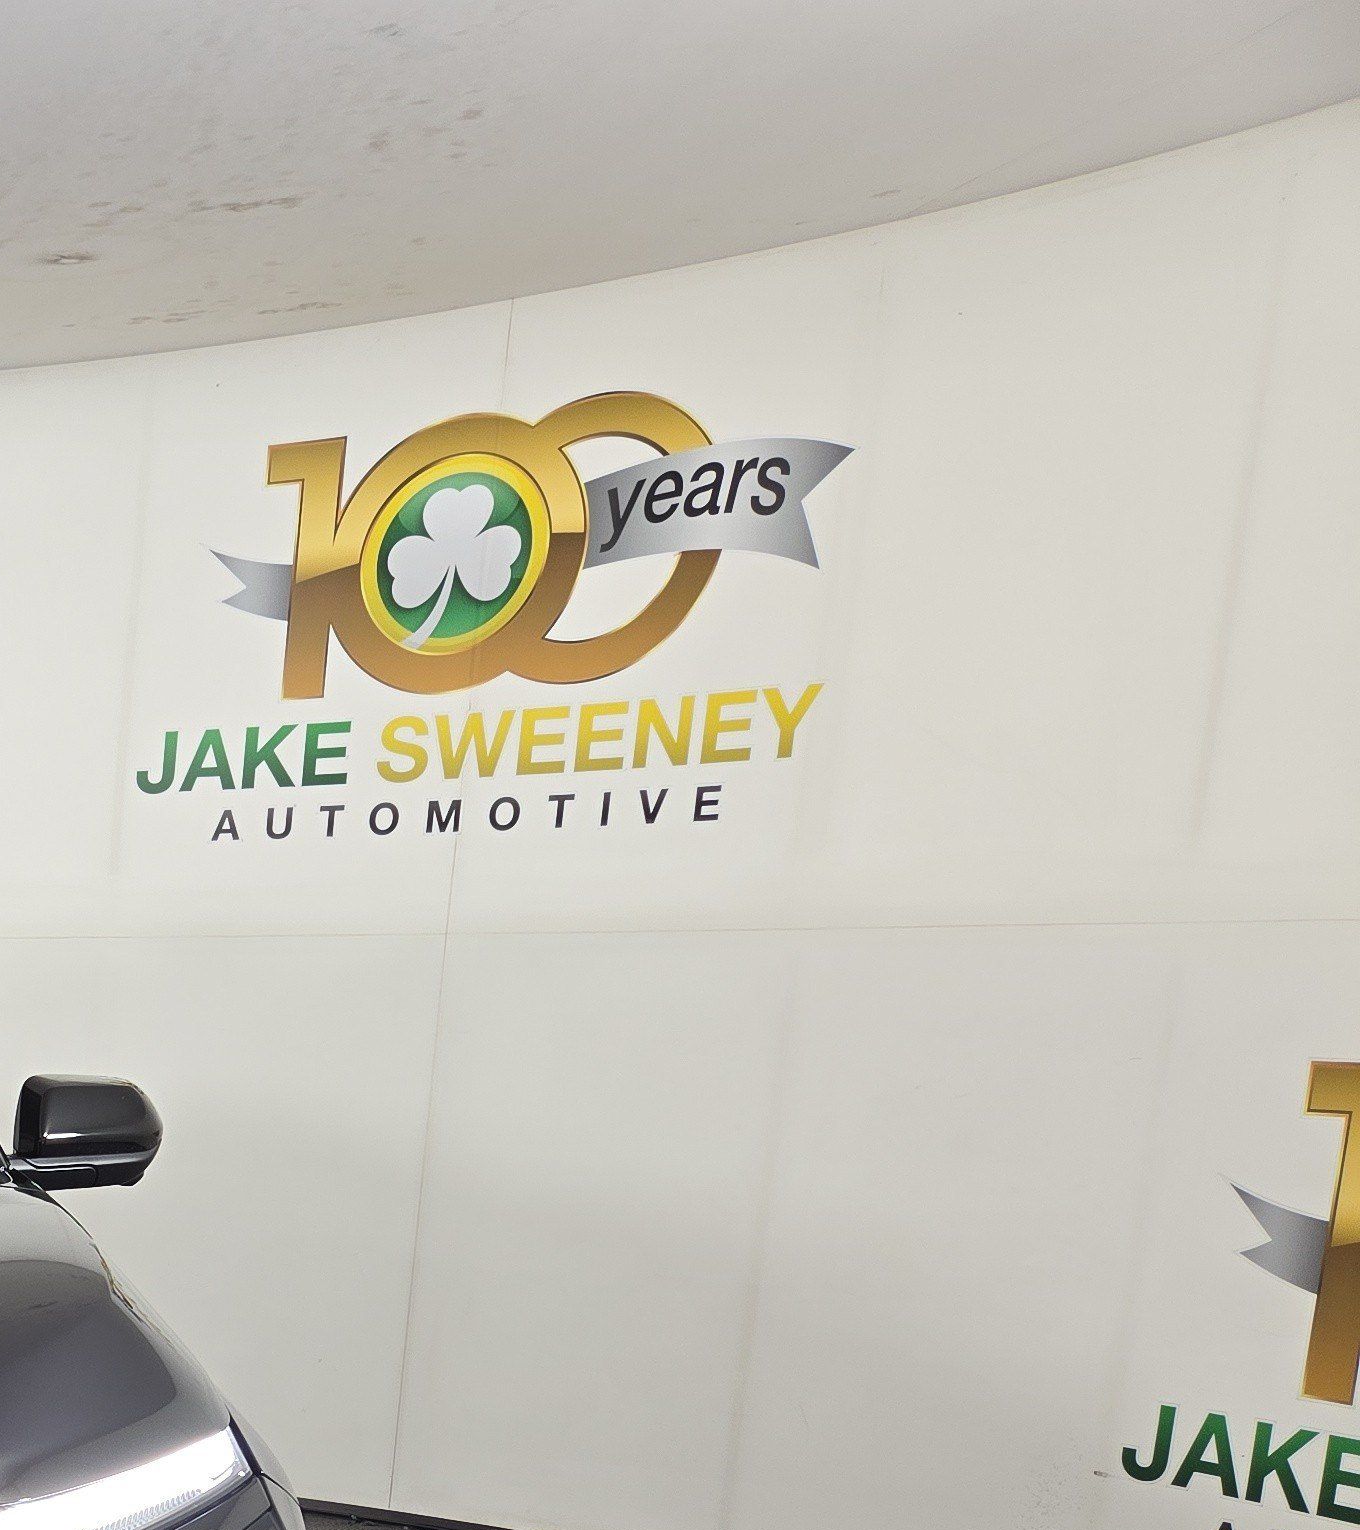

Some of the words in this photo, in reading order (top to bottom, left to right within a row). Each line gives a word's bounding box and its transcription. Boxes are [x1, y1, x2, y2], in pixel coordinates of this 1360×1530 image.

[266, 390, 724, 700] 100
[599, 455, 791, 552] years
[135, 719, 352, 795] JAKE
[376, 681, 826, 784] SWEENEY
[210, 785, 724, 842] AUTOMOTIVE
[1121, 1403, 1360, 1525] JAKE
